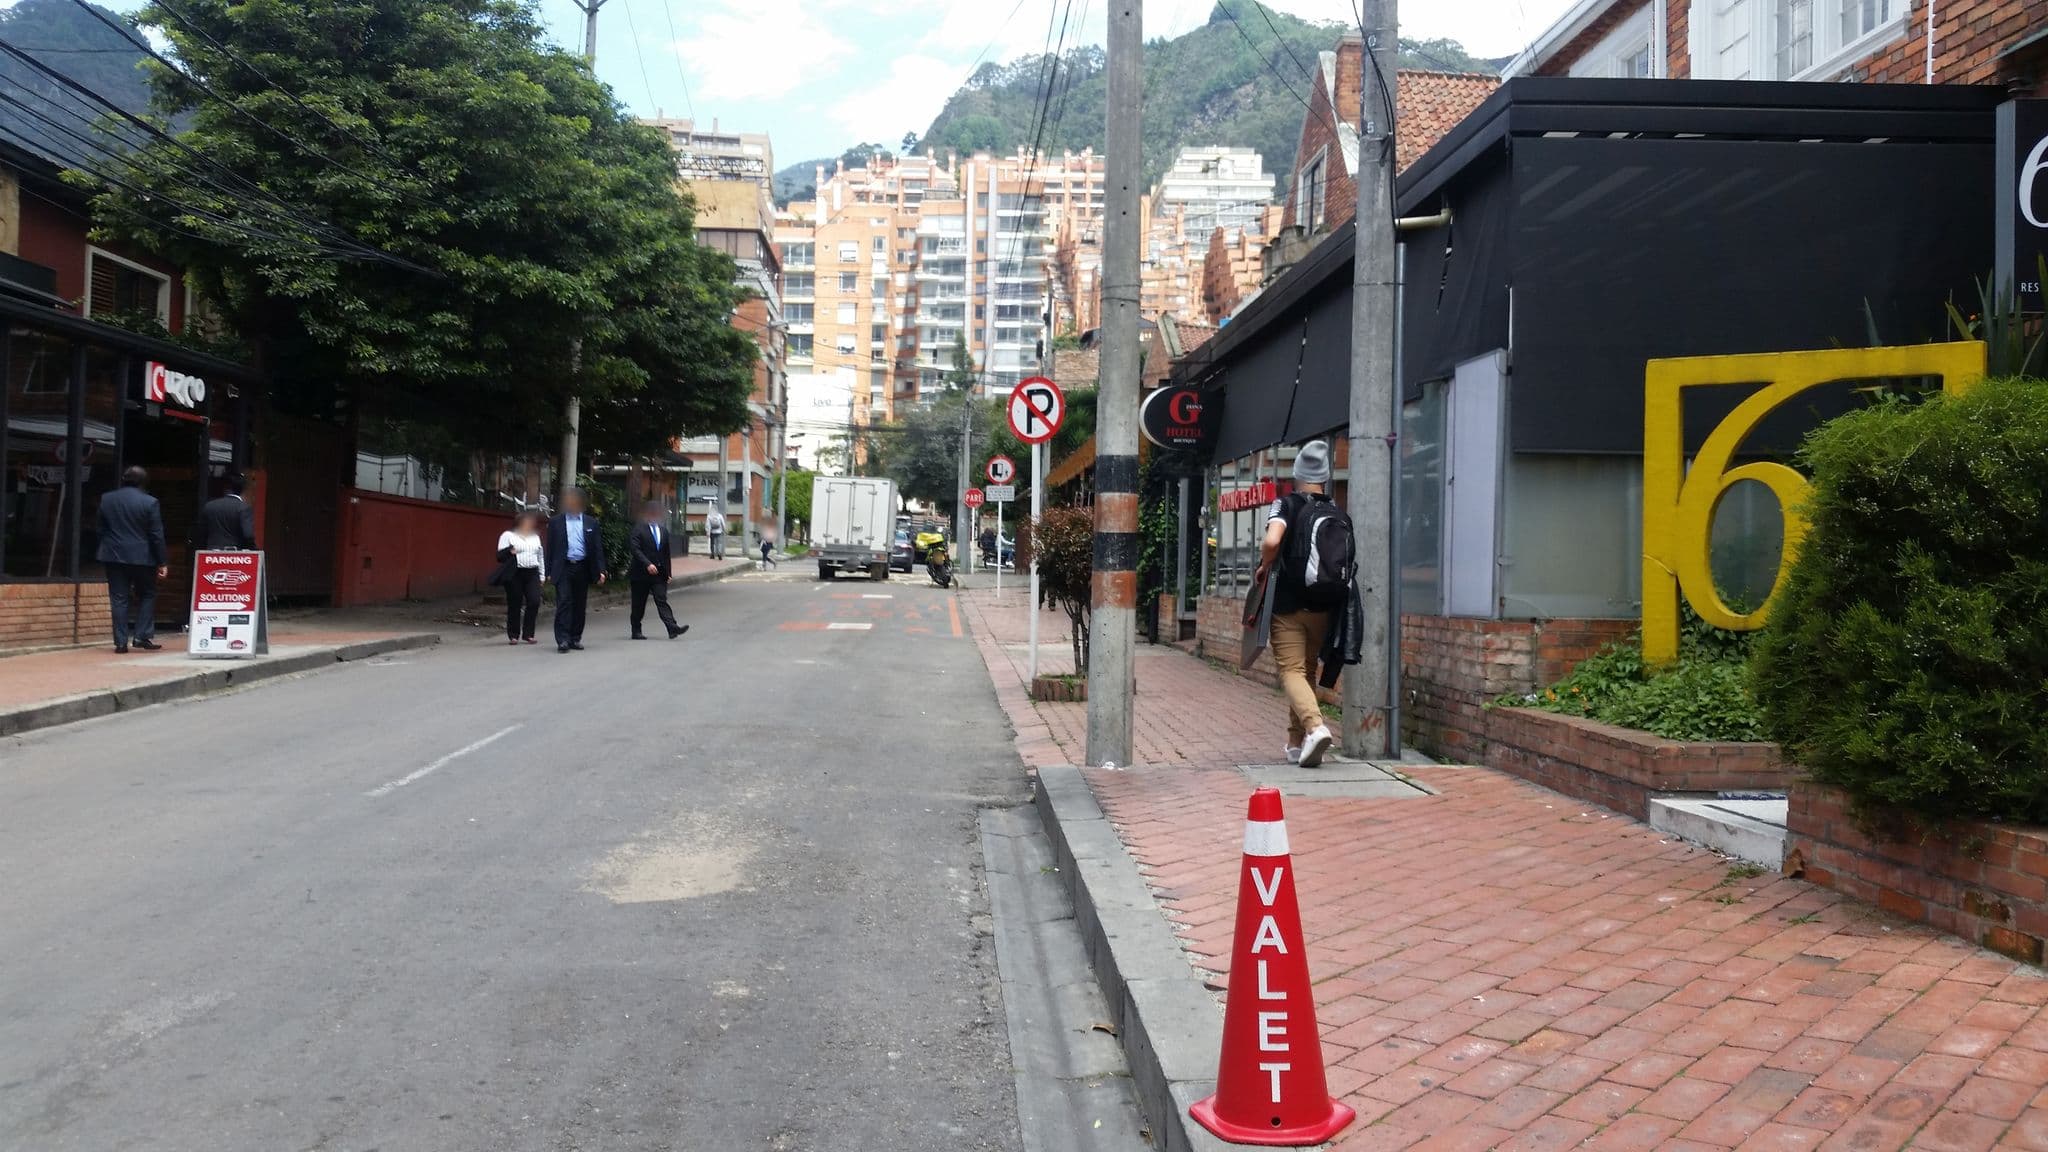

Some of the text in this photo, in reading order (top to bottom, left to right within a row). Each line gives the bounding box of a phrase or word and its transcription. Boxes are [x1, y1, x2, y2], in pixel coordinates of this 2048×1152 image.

[1366, 121, 1375, 133] 5
[1169, 391, 1199, 424] G
[1166, 427, 1203, 438] HOTEL
[965, 493, 982, 501] PARE
[205, 556, 252, 564] PARKING
[199, 593, 251, 602] SOLUTIONS
[1250, 867, 1290, 1103] VALET
